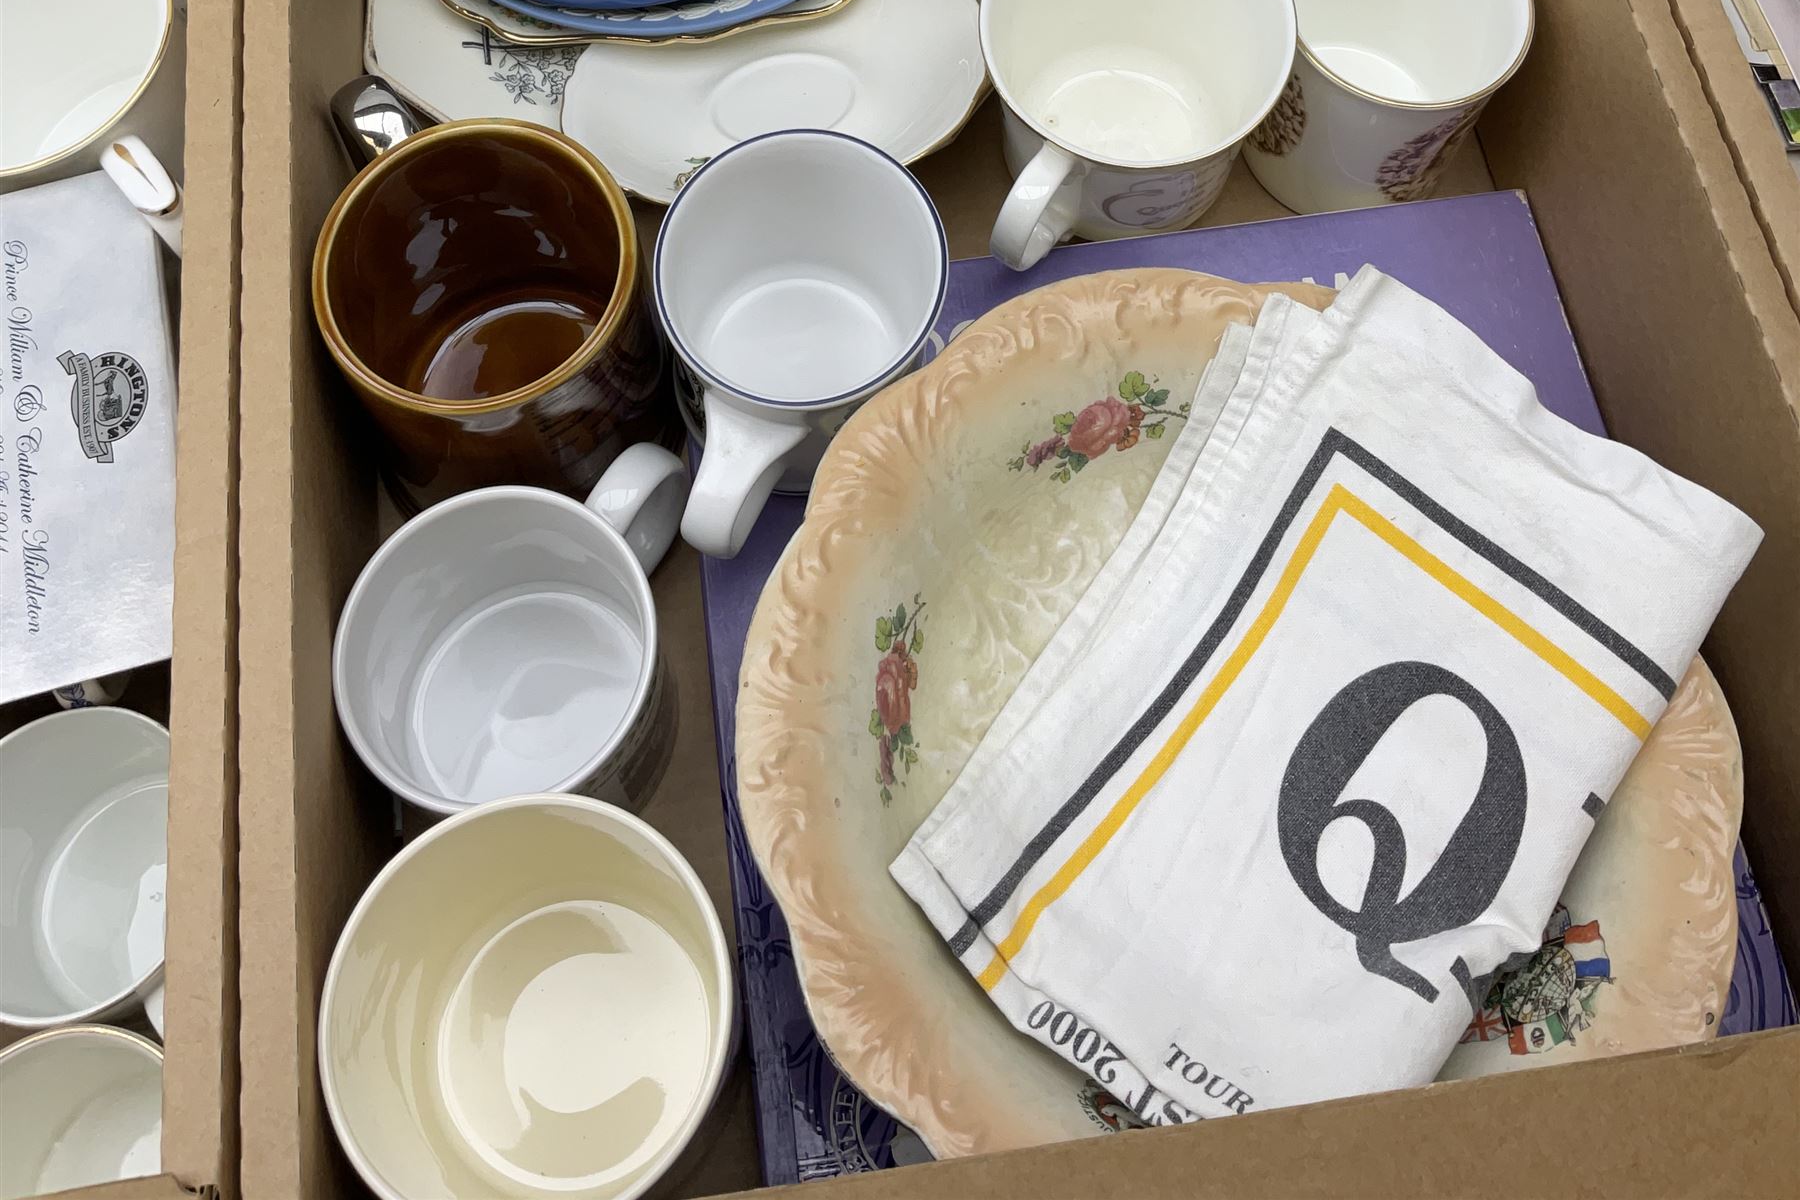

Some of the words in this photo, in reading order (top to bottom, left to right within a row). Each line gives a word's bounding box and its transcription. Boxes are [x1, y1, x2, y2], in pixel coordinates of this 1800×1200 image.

[3, 240, 29, 302] Prince
[7, 306, 39, 383] William
[78, 361, 90, 388] FAMILY
[14, 384, 48, 422] &
[81, 388, 92, 426] BUSINESS
[100, 355, 146, 440] RINGTONS
[16, 427, 43, 524] Catherine
[86, 440, 99, 455] 1907
[22, 529, 50, 636] Middleton
[1027, 1000, 1129, 1085] 2000
[1163, 1043, 1255, 1115] TOUR
